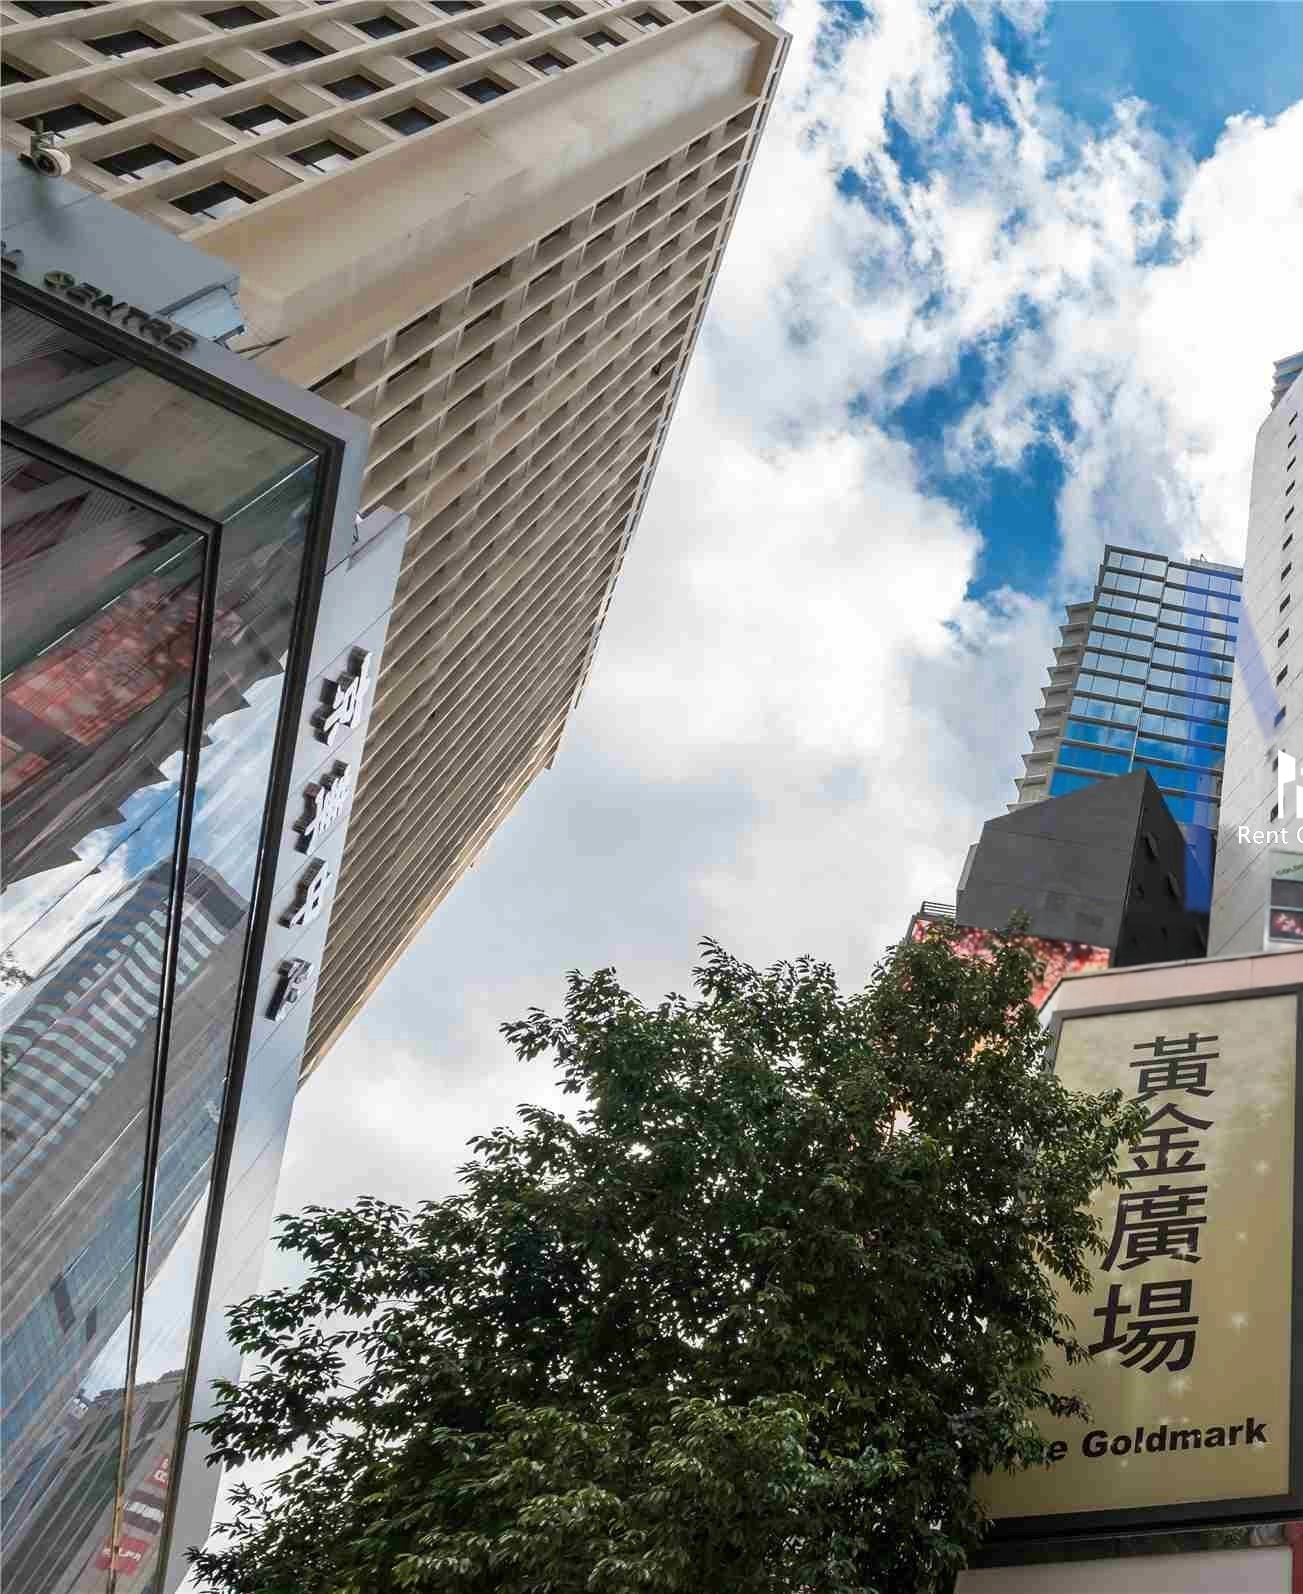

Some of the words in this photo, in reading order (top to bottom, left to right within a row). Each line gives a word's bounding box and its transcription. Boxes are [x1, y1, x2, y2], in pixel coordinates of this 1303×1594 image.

[44, 271, 197, 351] CENTRE
[1089, 1032, 1220, 1374] 黃金廣場
[1082, 1417, 1268, 1458] Goldmark
